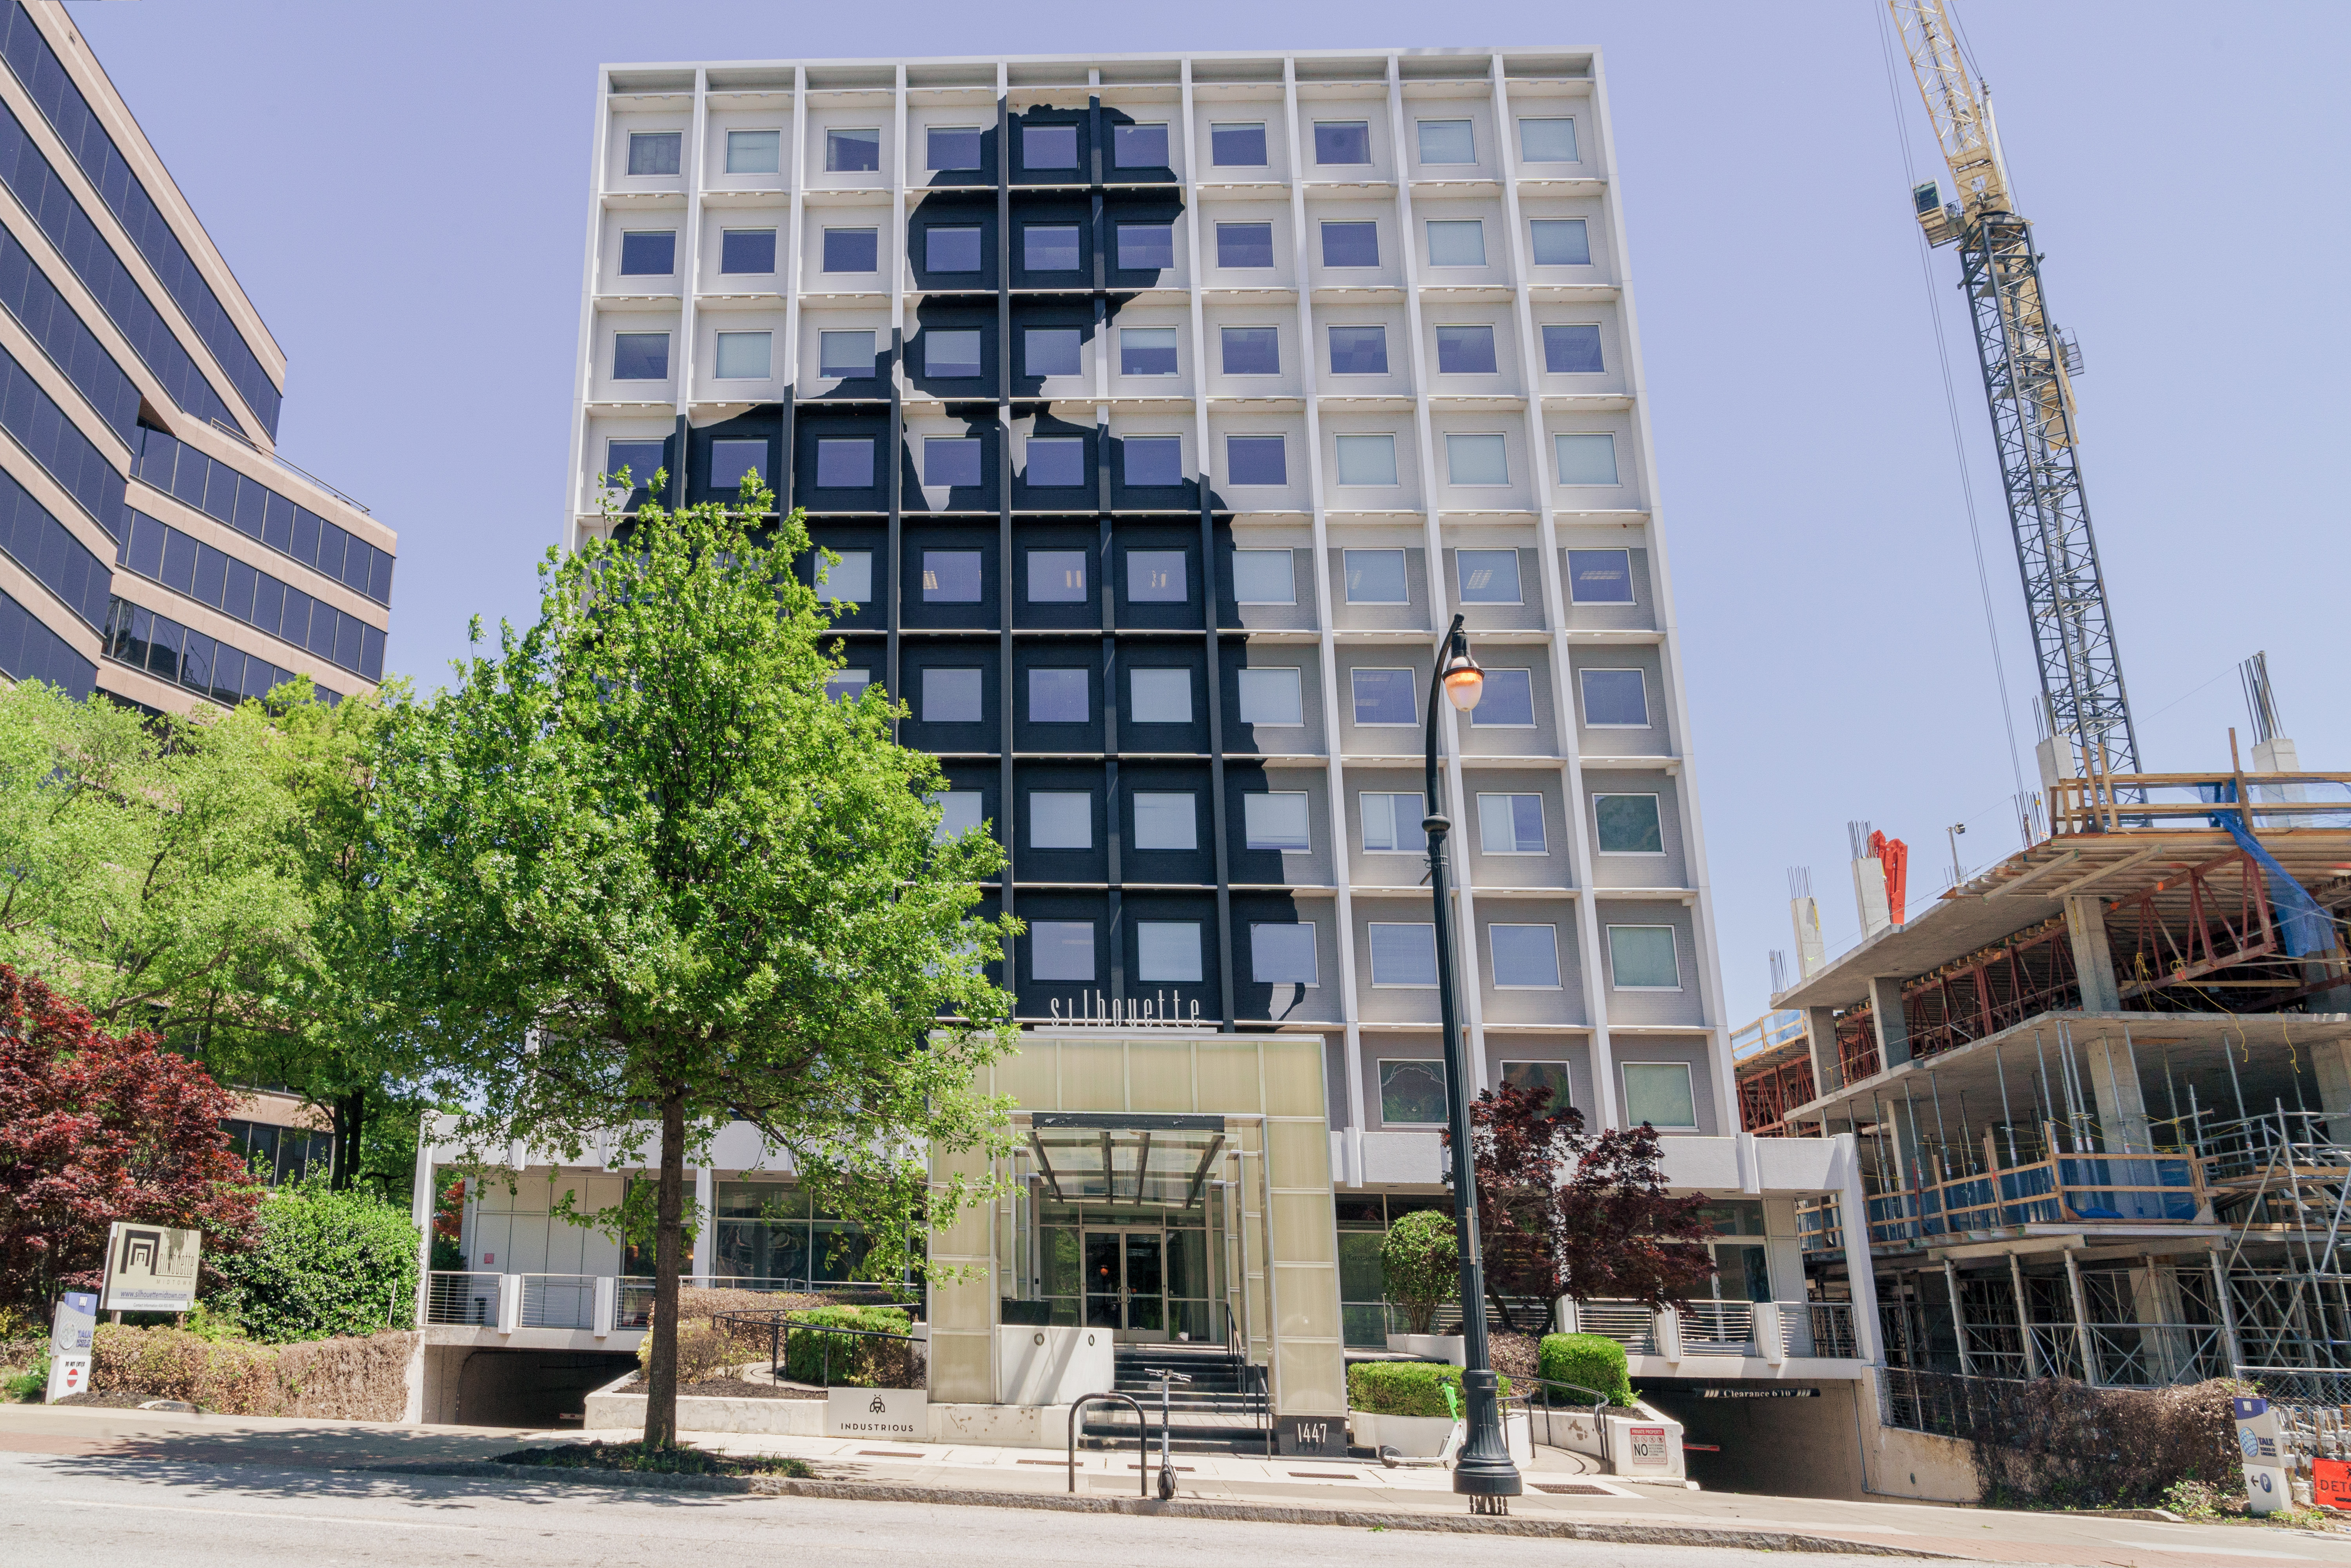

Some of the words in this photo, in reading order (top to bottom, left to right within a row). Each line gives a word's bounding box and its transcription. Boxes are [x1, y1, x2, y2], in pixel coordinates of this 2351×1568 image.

[1051, 989, 1199, 1028] silhouette
[120, 1290, 187, 1299] www.silhouettemidtown.com
[841, 1423, 913, 1432] INDUSTRIOUS
[1297, 1423, 1327, 1443] 1447
[2258, 1437, 2275, 1446] TALK
[1634, 1444, 1648, 1456] NO
[2320, 1479, 2351, 1492] DET
